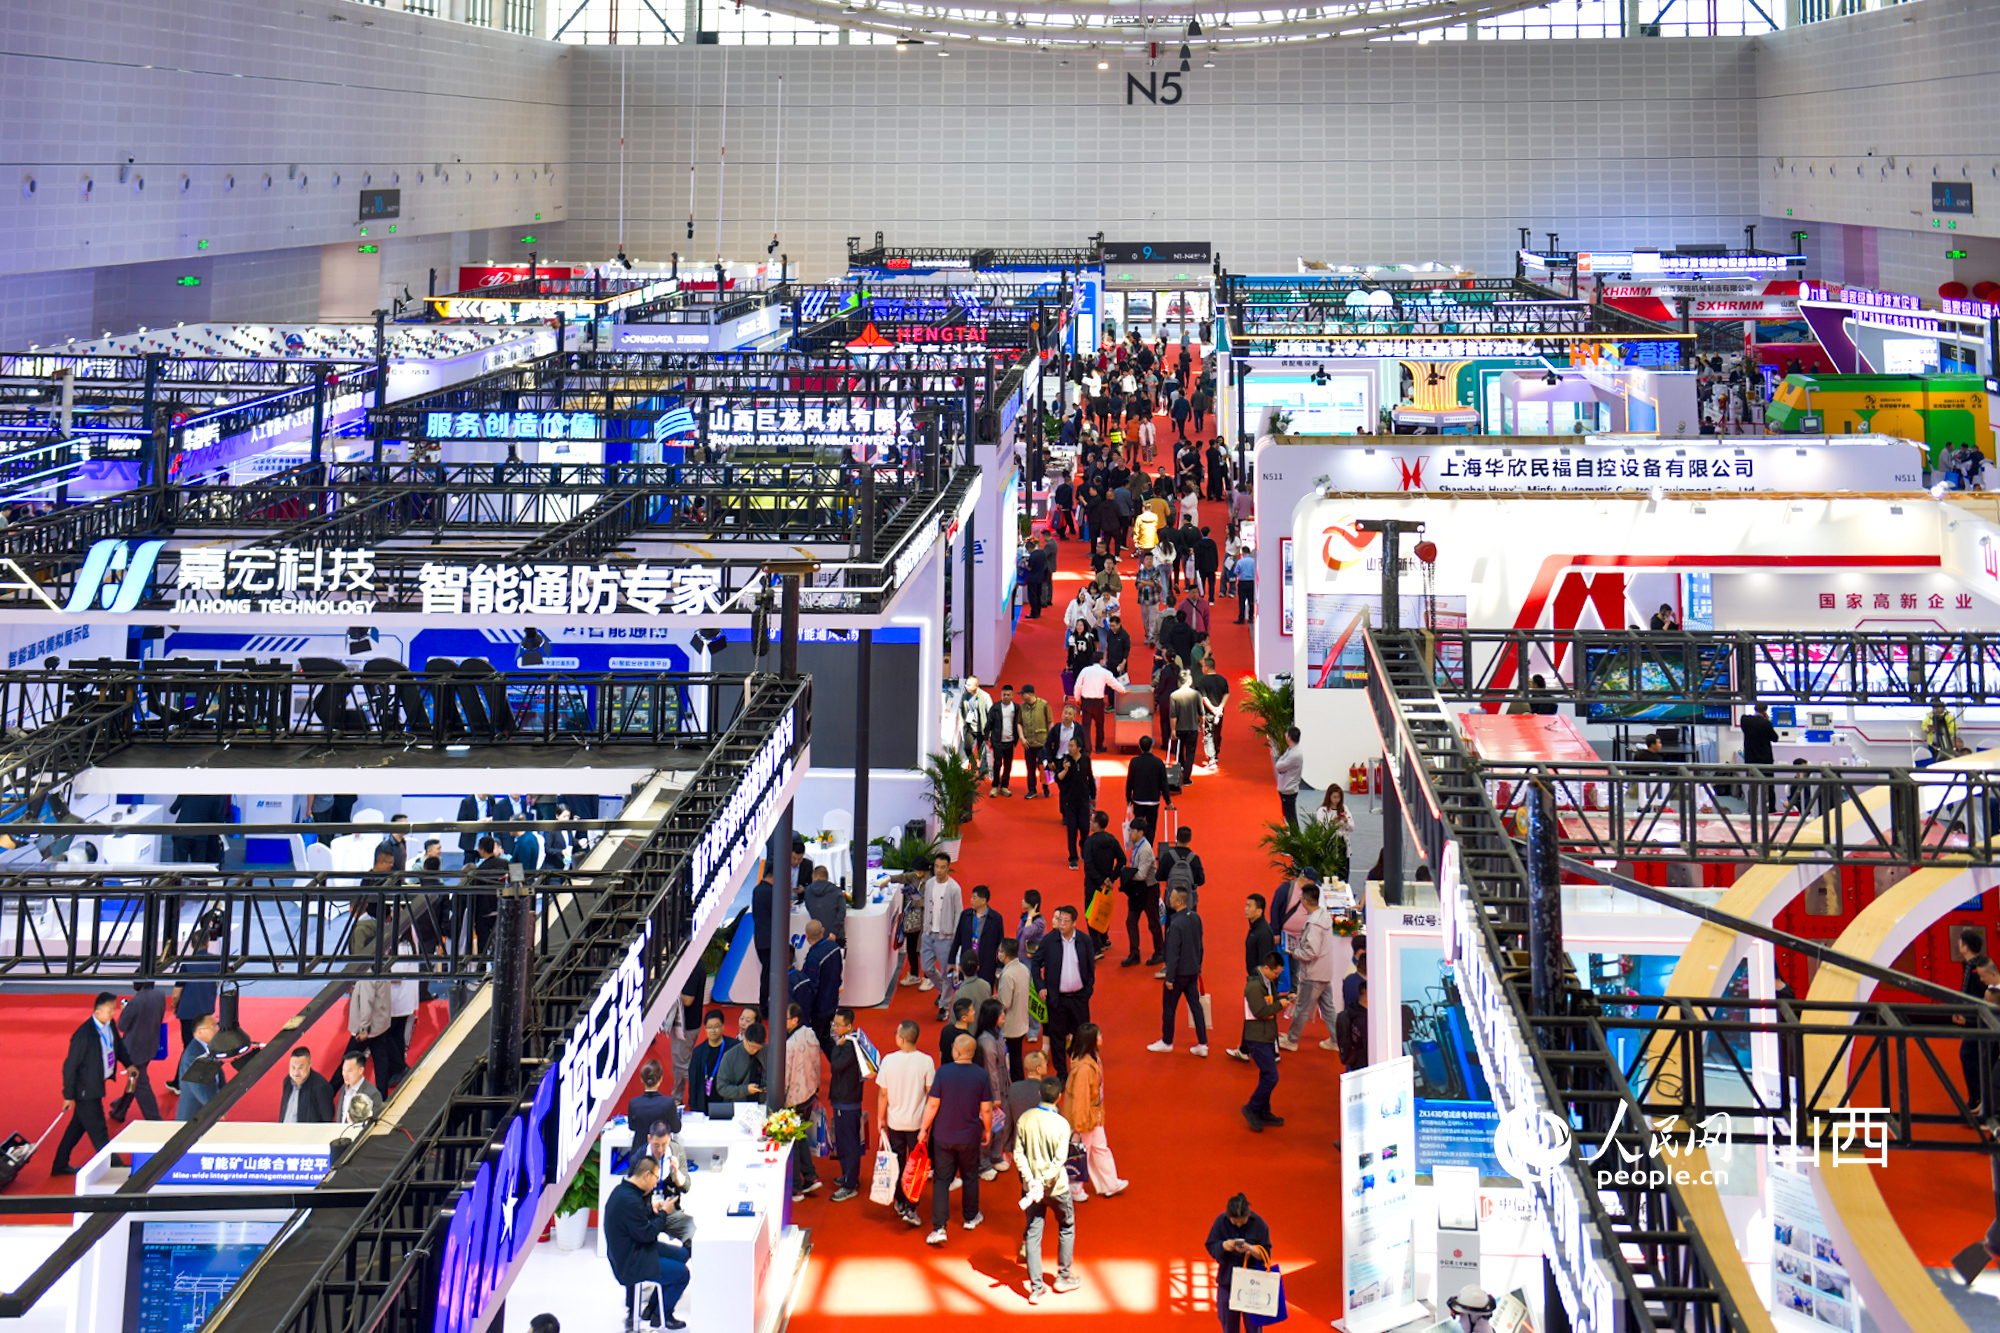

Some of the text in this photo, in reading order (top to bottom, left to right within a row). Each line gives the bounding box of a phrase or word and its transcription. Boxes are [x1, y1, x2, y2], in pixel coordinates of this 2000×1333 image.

[1127, 72, 1182, 104] N5
[1142, 246, 1152, 260] 9
[1696, 301, 1764, 311] SXHRMM
[897, 327, 986, 342] HENGTAI
[426, 412, 596, 438] 服务创造价值
[709, 408, 942, 432] 山西巨龙风机有限公
[710, 434, 755, 445] SHANXI
[756, 434, 803, 445] JULONG
[806, 434, 896, 446] FAN&BLOWERS
[1440, 457, 1754, 478] 上海华欣民福自控设备有限公司
[1262, 473, 1283, 481] N511
[1894, 474, 1917, 482] N511
[177, 547, 376, 592] 嘉宏科技
[418, 561, 724, 617] 智能通防专家
[170, 598, 377, 615] JIAHONG TECHNOLOGY
[1819, 593, 1973, 610] 国家高新企业
[8, 624, 90, 669] 智能通风模拟展示区
[556, 932, 646, 1185] 梅安森
[200, 1156, 328, 1171] 智能矿山综合管控平
[210, 1171, 248, 1181] integrated
[248, 1172, 295, 1181] management
